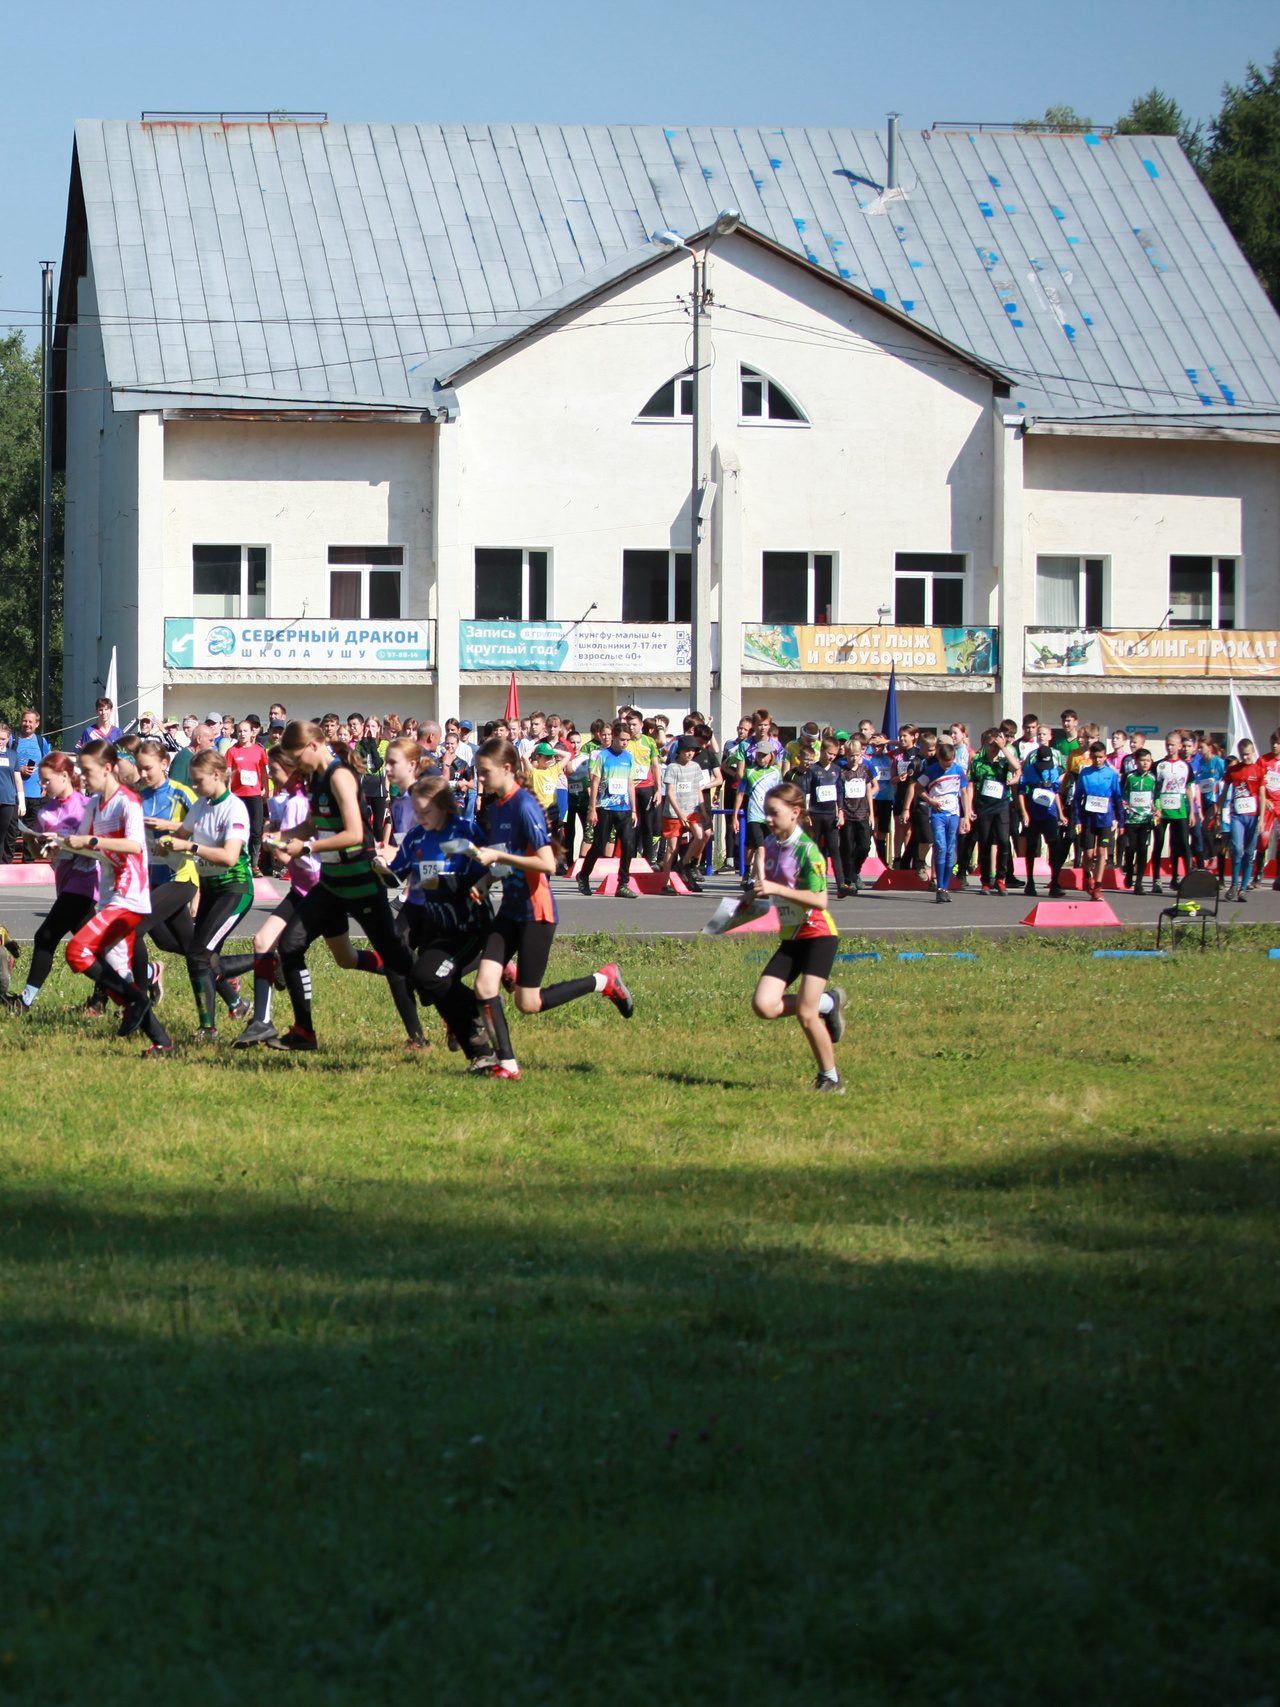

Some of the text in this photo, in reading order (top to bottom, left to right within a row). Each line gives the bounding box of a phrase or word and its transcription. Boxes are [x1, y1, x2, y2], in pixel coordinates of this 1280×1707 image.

[241, 627, 419, 646] СЕВЕРНЫЙ ДРАКОН
[466, 626, 517, 639] Запись
[578, 631, 663, 641] кунгфу-малыш 4+
[578, 642, 631, 650] школьники
[632, 642, 650, 650] 7-17
[814, 633, 932, 649] ПРОКАТ ЛЫЖ
[241, 649, 366, 659] ШКОЛА УШУ
[466, 644, 527, 657] круглый
[1107, 639, 1279, 659] ТЮБИНГ-ПРОКАТ
[578, 653, 624, 662] взрослые
[807, 650, 938, 667] И СНОУБОРДОВ
